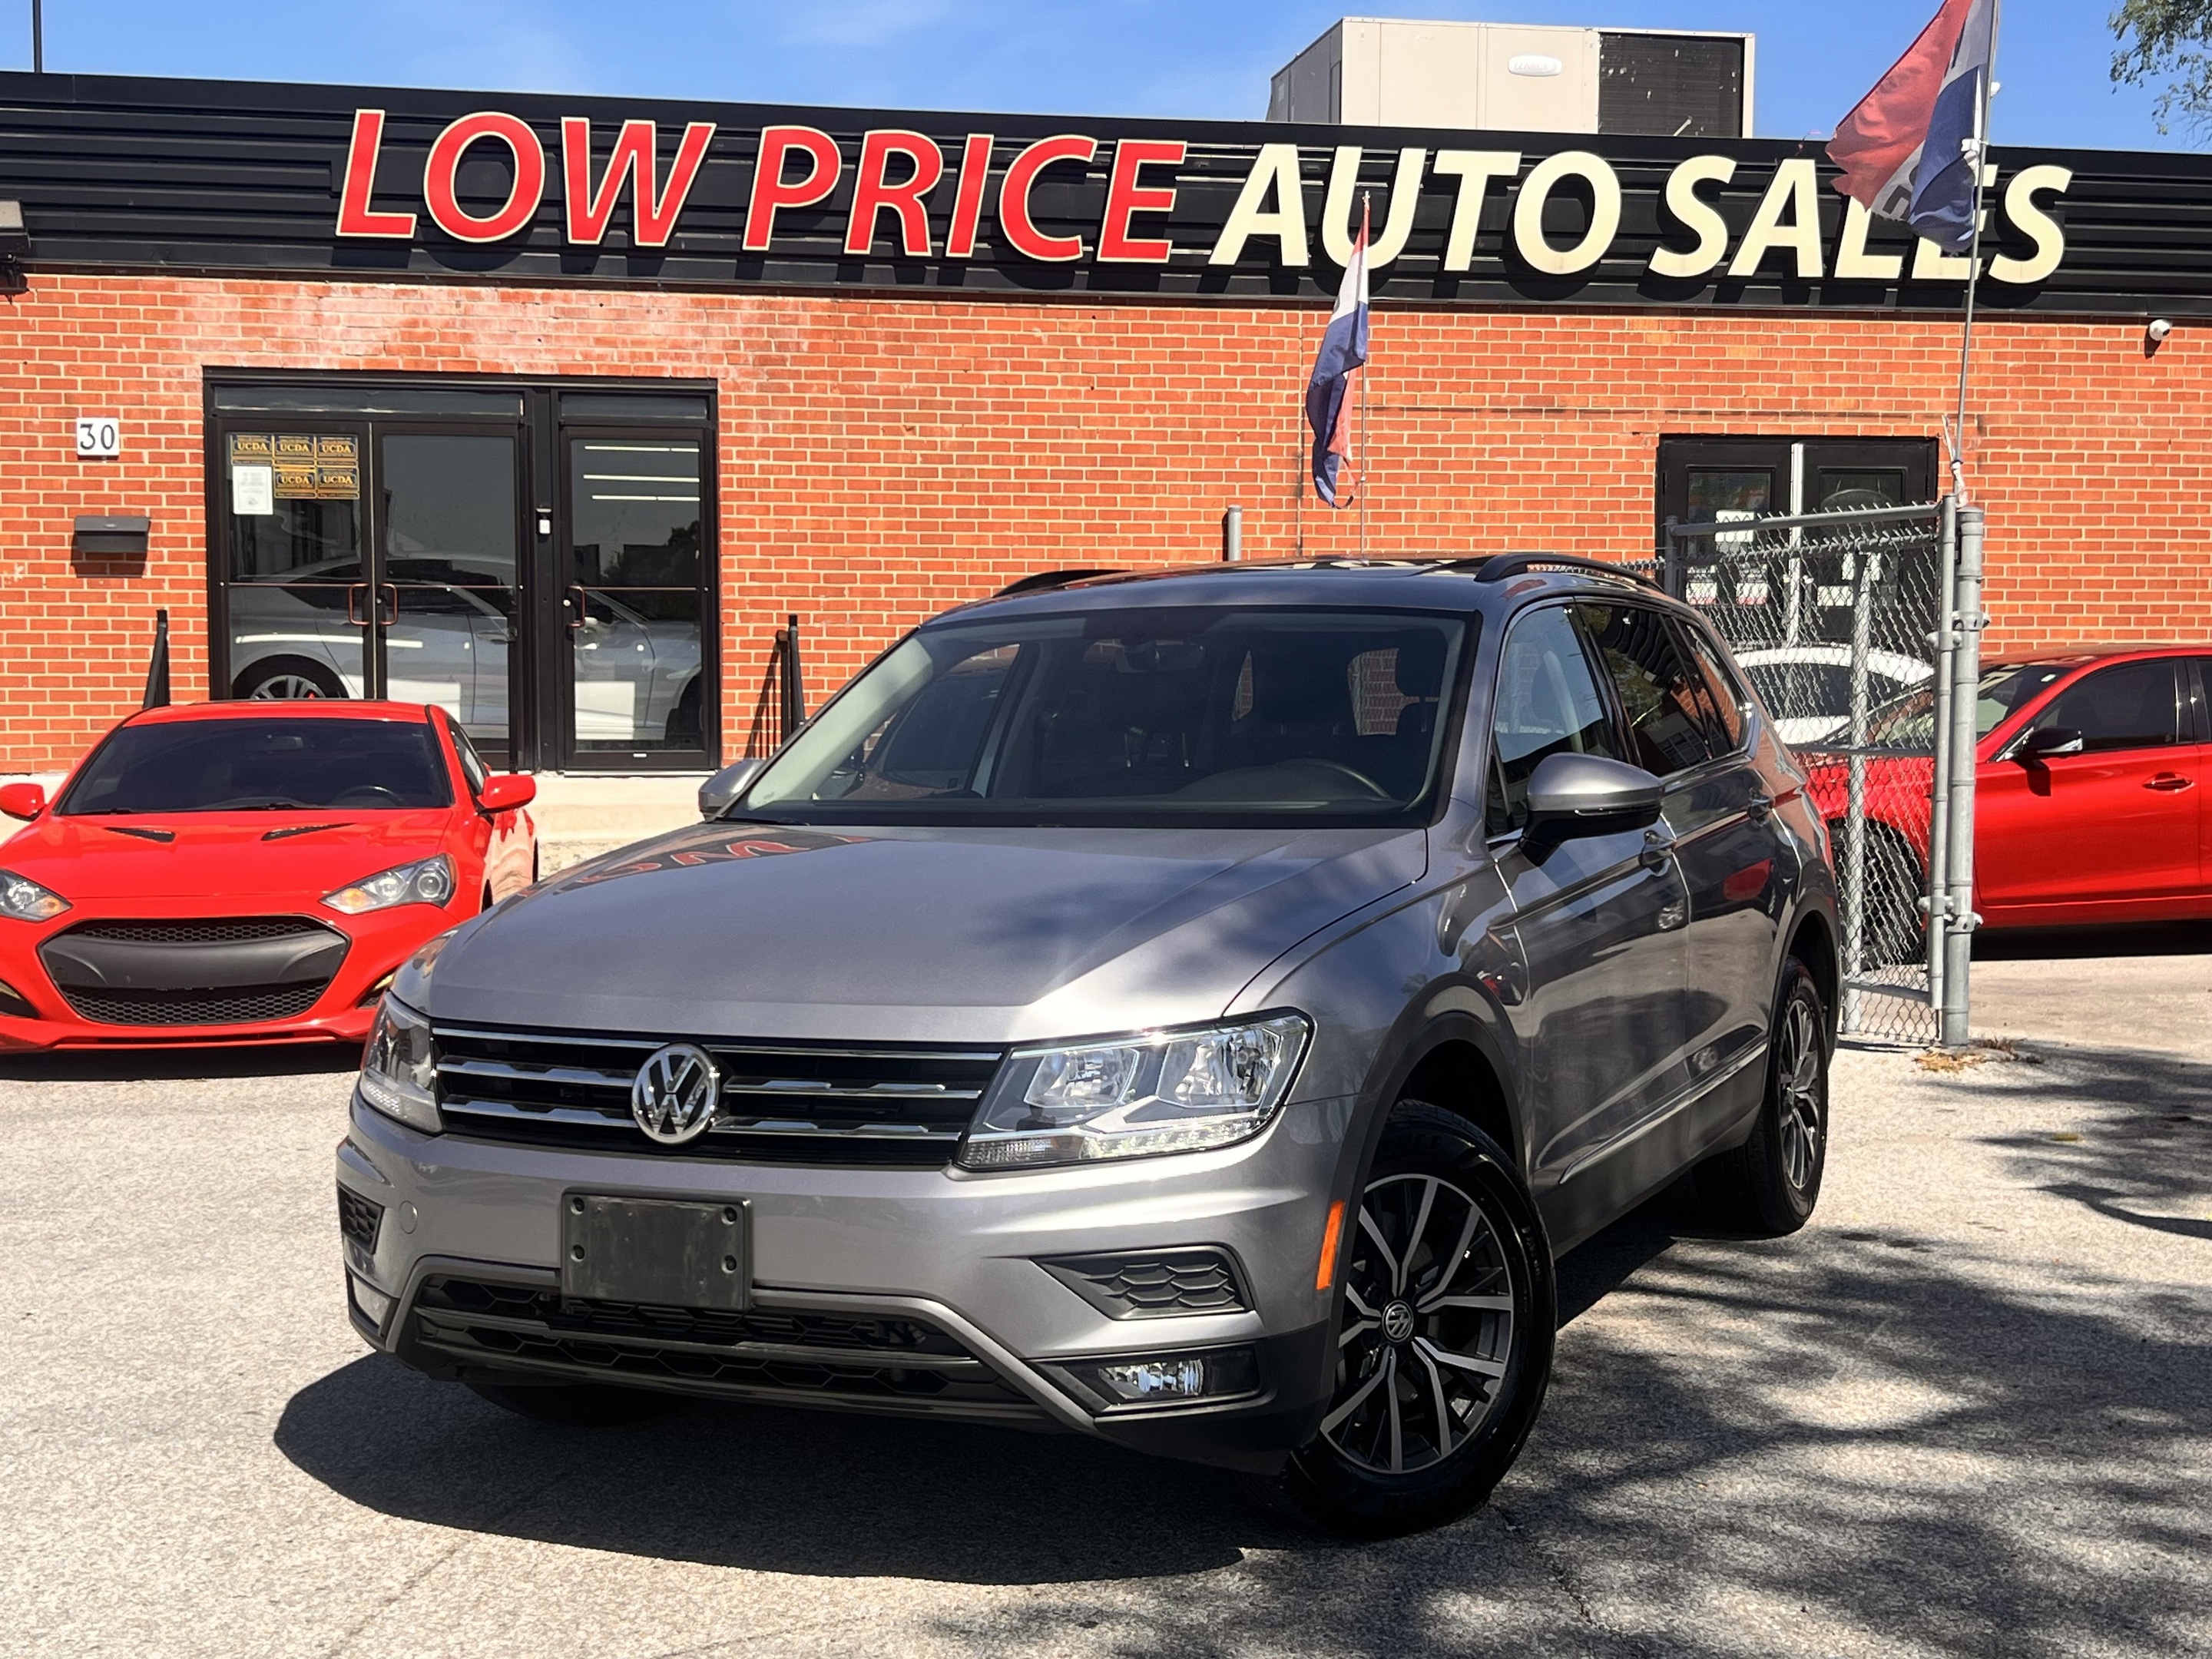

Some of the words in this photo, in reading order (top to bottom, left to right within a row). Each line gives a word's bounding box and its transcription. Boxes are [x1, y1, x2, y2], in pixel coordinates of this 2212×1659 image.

[336, 108, 717, 247] LOW
[742, 125, 1188, 263] PRICE
[1208, 143, 1622, 275] AUTO
[80, 423, 115, 450] 30
[237, 442, 268, 451] UCDA
[280, 444, 310, 452] UCDA
[322, 445, 352, 453] UCDA
[281, 475, 310, 485] UCDA
[323, 475, 353, 485] UCDA
[634, 1045, 717, 1141] VW
